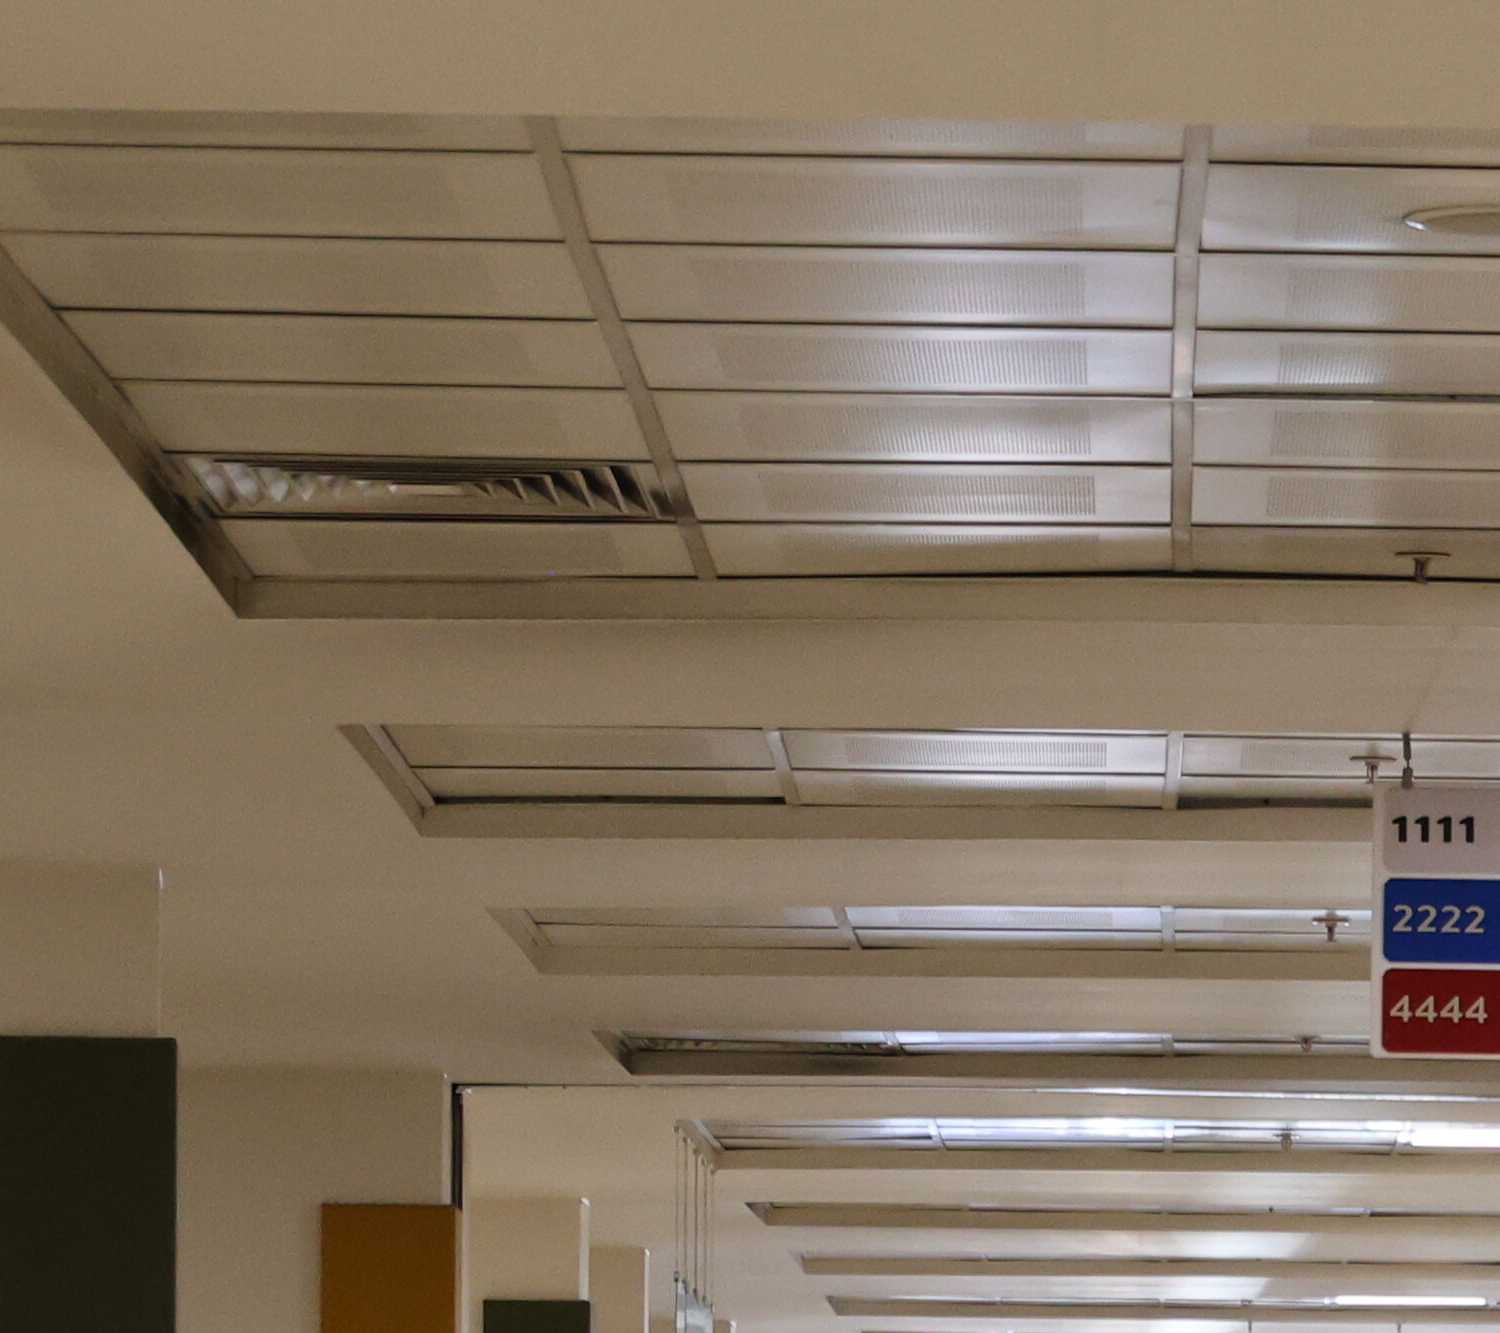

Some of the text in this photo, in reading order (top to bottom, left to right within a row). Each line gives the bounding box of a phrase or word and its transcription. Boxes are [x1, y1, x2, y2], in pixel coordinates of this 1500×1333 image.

[1391, 815, 1476, 844] 1111
[1391, 903, 1486, 935] 2222
[1389, 995, 1489, 1024] 4444
